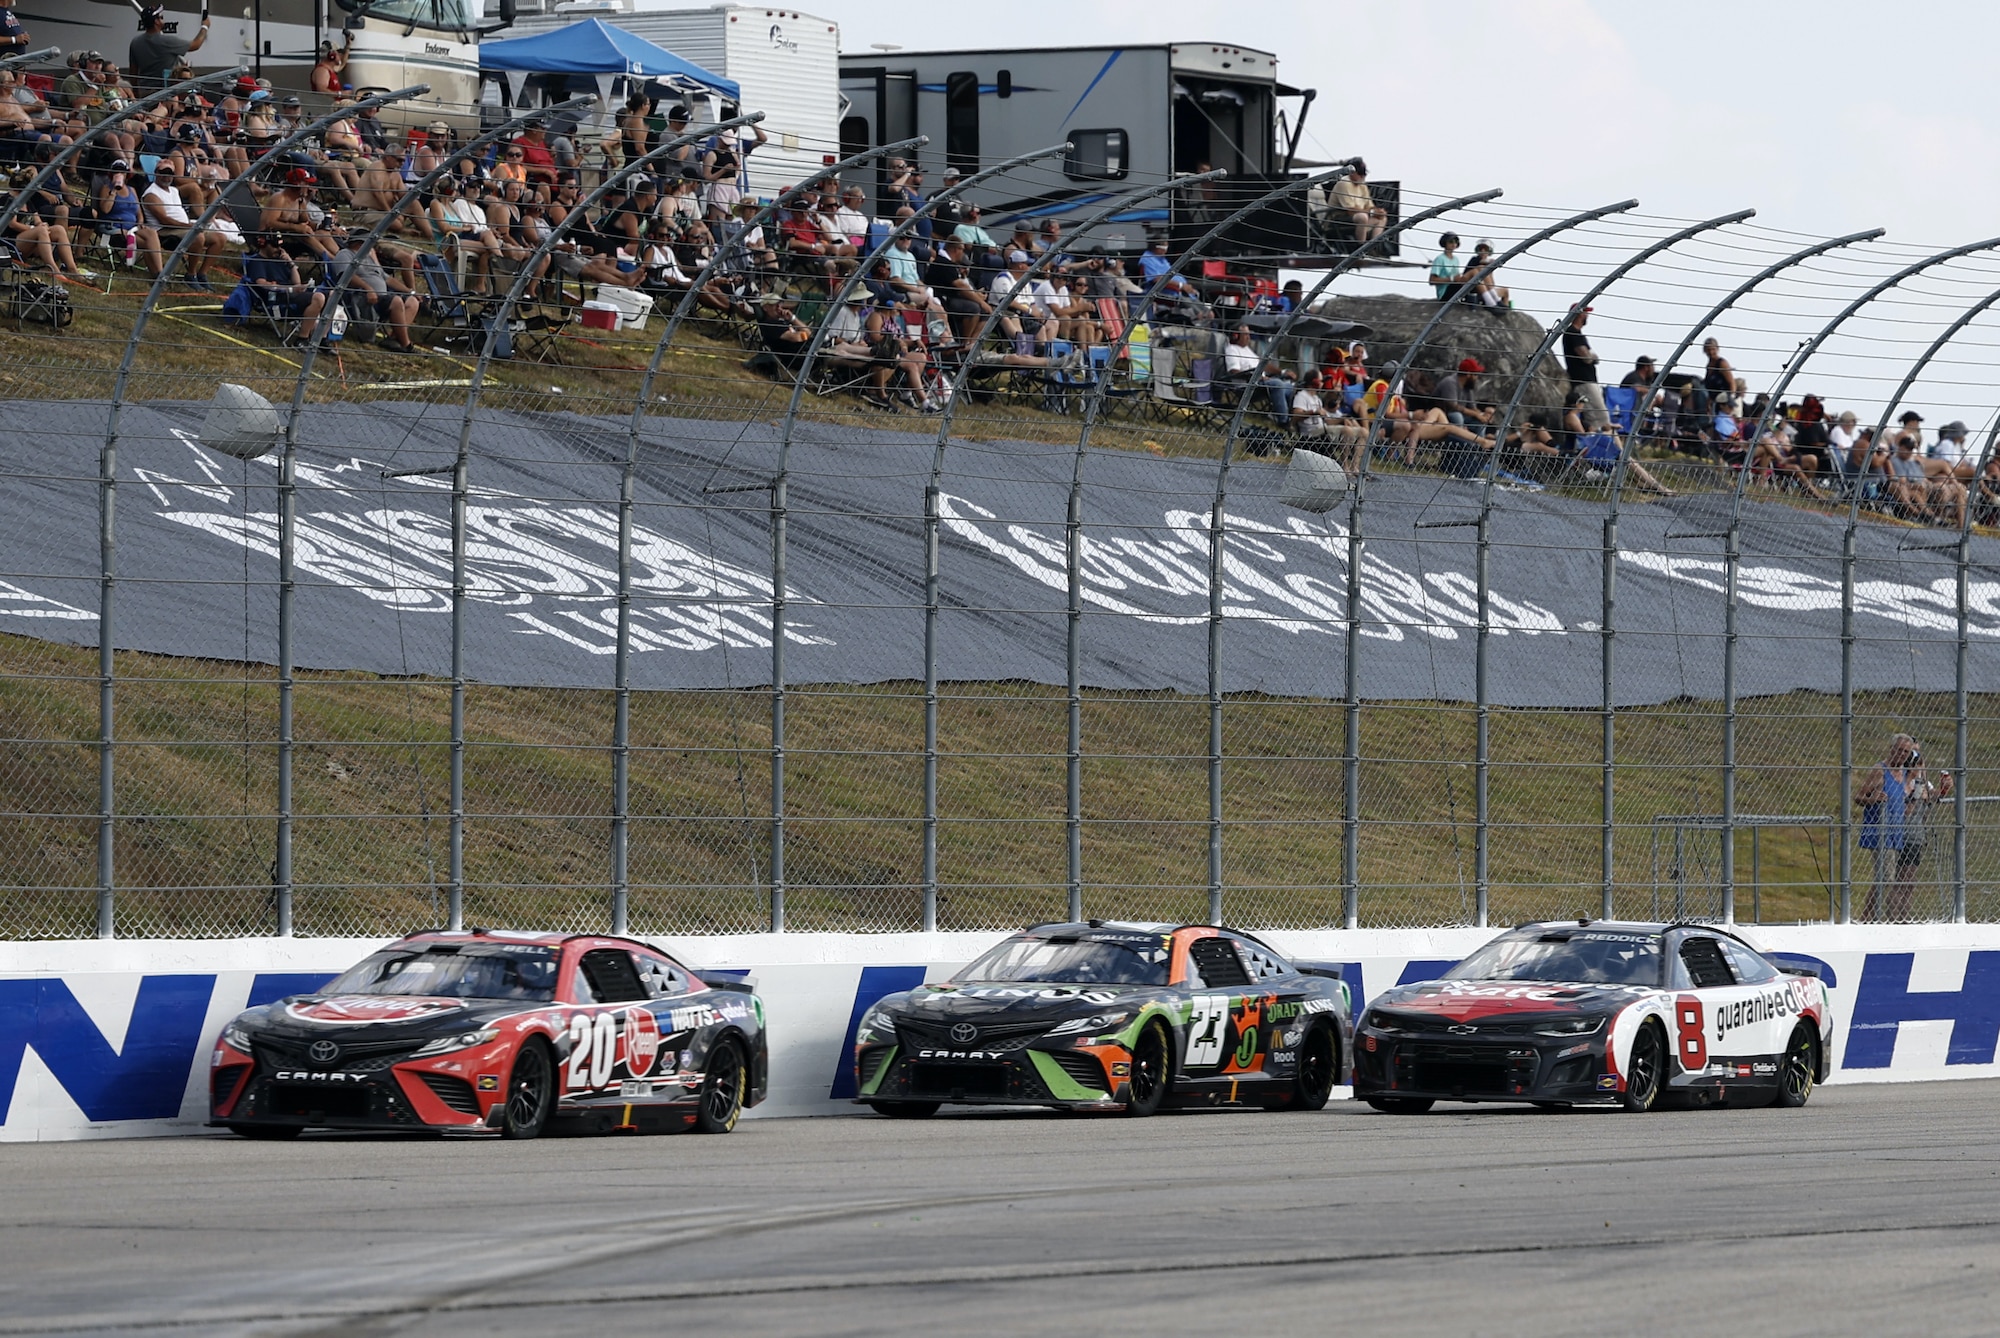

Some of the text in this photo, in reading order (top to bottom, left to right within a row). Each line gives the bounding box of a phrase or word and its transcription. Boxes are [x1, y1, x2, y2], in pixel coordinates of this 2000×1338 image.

[1090, 934, 1153, 942] WALLACE
[1584, 933, 1658, 944] REDDICK
[502, 944, 548, 955] BELL
[671, 1004, 715, 1031] WATTS
[1717, 982, 1800, 1042] guaranteed
[1184, 994, 1229, 1066] 23
[1675, 993, 1708, 1072] 8
[567, 1012, 617, 1089] 20
[1366, 1036, 1377, 1052] 8
[919, 1050, 1004, 1060] CAMRY
[1273, 1051, 1296, 1063] Root
[276, 1071, 369, 1082] CAMRY
